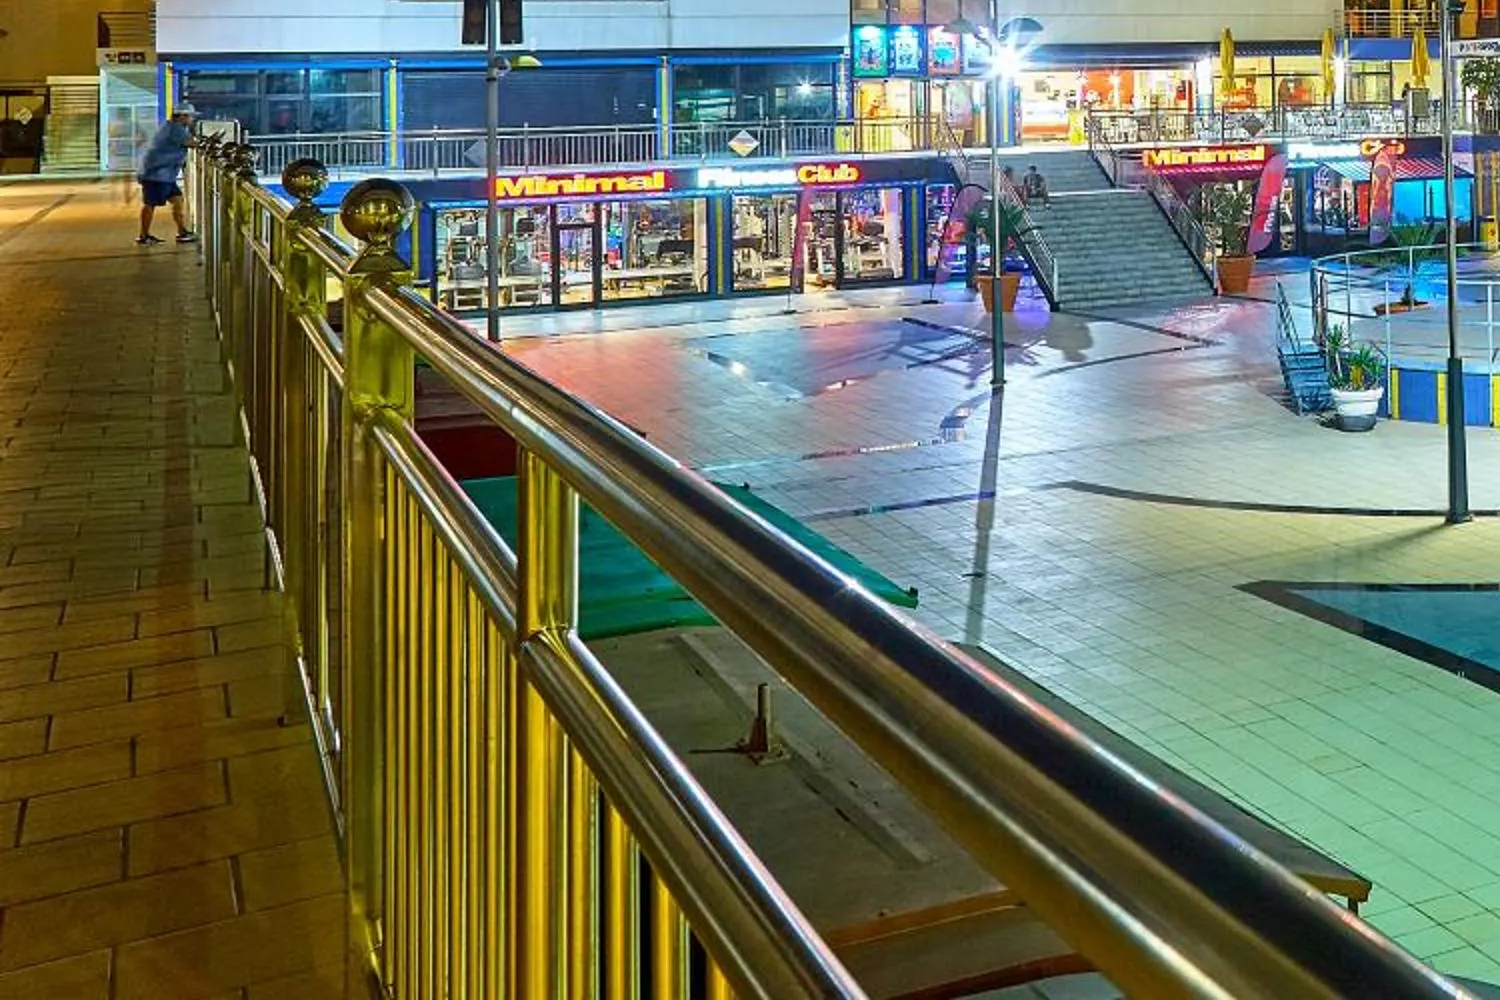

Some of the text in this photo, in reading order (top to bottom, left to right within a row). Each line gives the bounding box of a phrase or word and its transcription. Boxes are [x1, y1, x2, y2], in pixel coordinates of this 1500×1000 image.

[1142, 145, 1265, 166] Minimal
[495, 171, 665, 196] Minimal
[798, 164, 859, 183] Club
